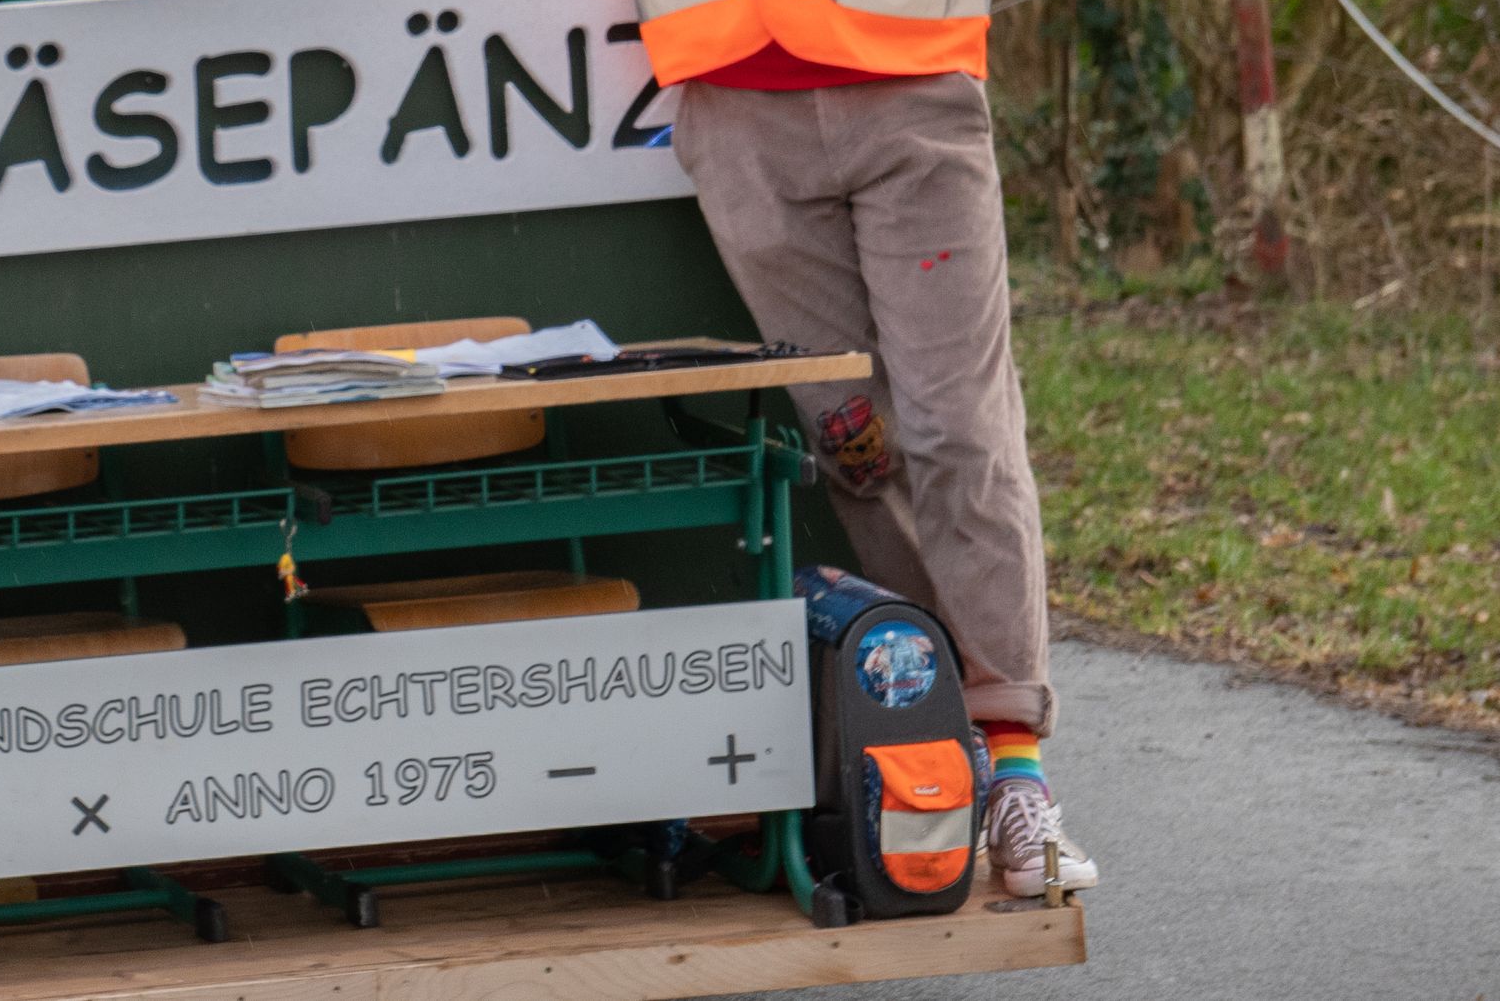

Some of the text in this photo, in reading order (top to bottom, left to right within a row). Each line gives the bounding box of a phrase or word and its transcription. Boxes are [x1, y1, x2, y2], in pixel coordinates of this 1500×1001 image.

[300, 639, 796, 730] ECHTERSHAUSEN
[164, 766, 336, 825] ANNO
[364, 752, 498, 807] 1975
